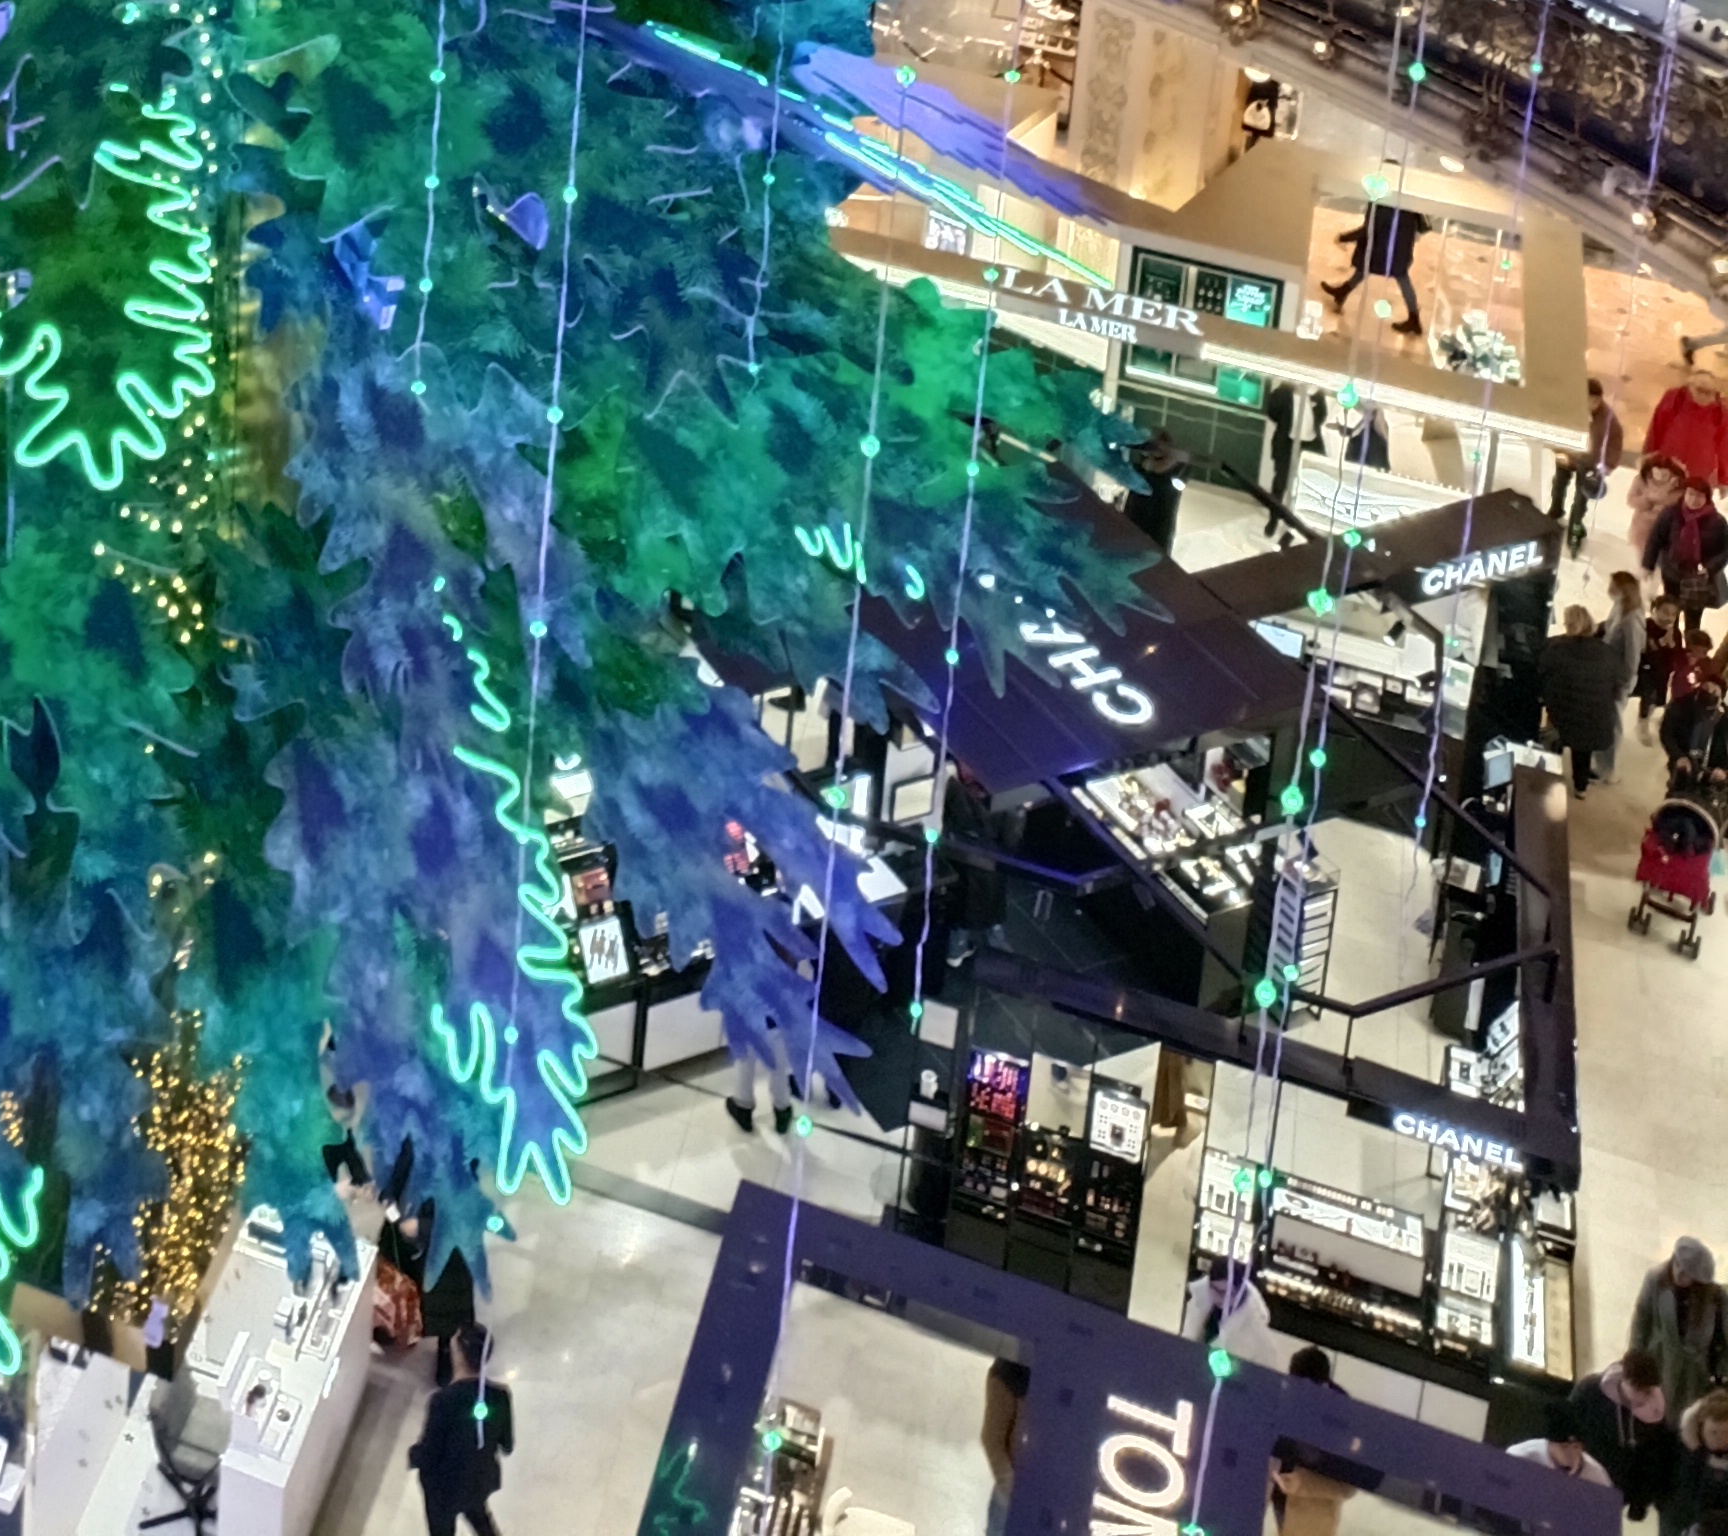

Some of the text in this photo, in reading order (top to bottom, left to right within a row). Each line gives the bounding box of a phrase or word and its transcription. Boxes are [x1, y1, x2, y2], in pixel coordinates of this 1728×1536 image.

[998, 266, 1069, 303] LA
[1082, 286, 1204, 336] MER
[1059, 308, 1138, 344] LA MER
[1422, 540, 1544, 596] CHANEL
[1392, 1112, 1524, 1173] CHANEL
